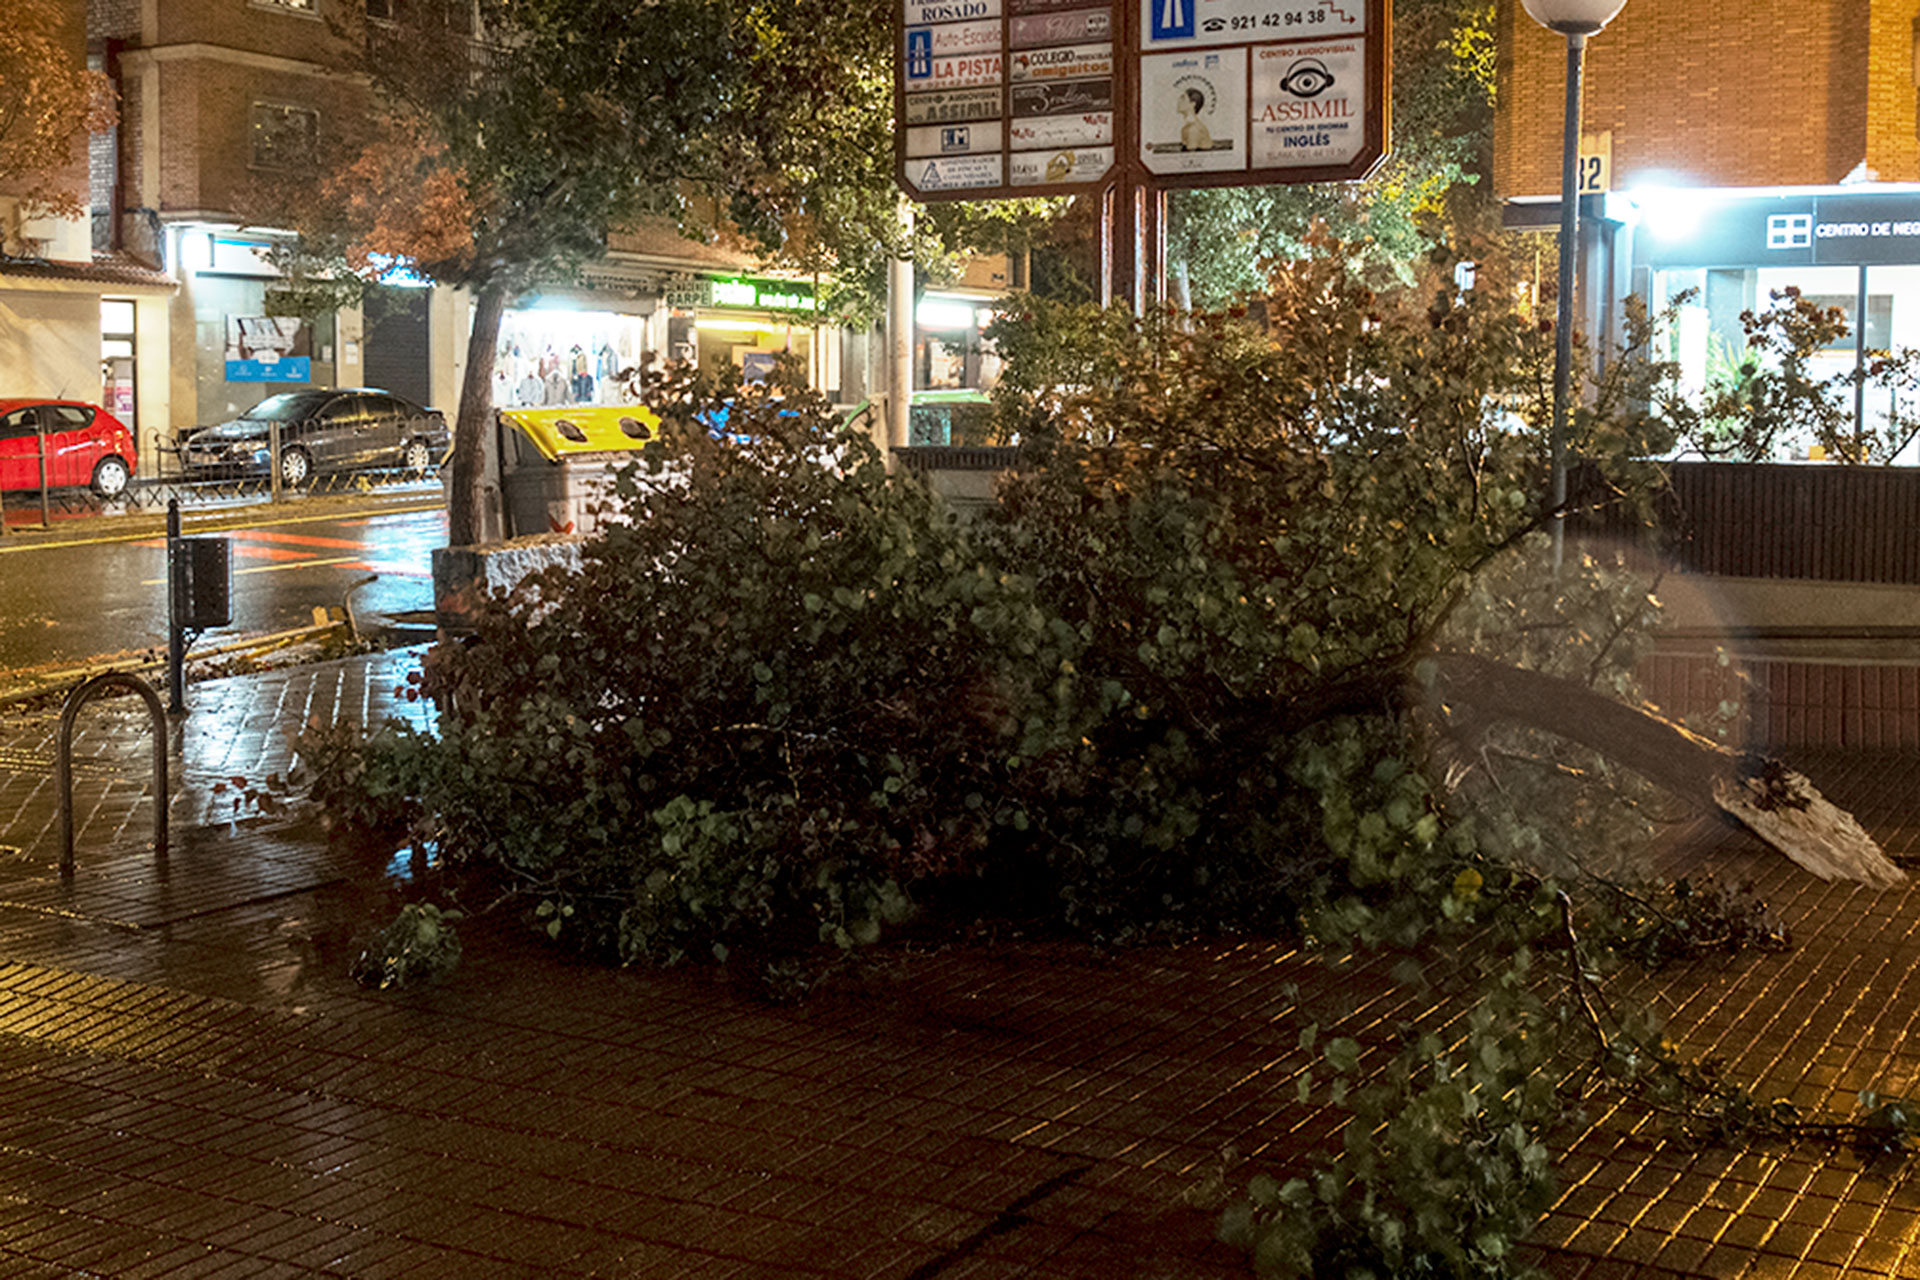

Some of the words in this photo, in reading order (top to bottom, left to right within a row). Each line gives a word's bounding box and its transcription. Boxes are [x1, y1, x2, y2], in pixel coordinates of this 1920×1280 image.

[922, 2, 987, 21] ROSADO
[1230, 15, 1256, 30] 921
[1262, 13, 1280, 27] 42
[1284, 11, 1303, 26] 94
[1307, 9, 1325, 24] 38
[1030, 50, 1075, 66] COLEGIO
[1259, 48, 1294, 60] CENTRO
[1296, 44, 1355, 56] AUDIOVISUAL
[935, 62, 954, 79] LA
[958, 57, 1002, 77] PISTA
[1032, 62, 1109, 78] amiguitos
[926, 100, 1001, 121] ASSIMIL
[1261, 98, 1356, 122] ASSIMIL
[1283, 132, 1331, 148] INGLÉS
[1815, 223, 1869, 238] CENTRO
[1871, 222, 1892, 236] DE
[666, 291, 709, 305] GARPE
